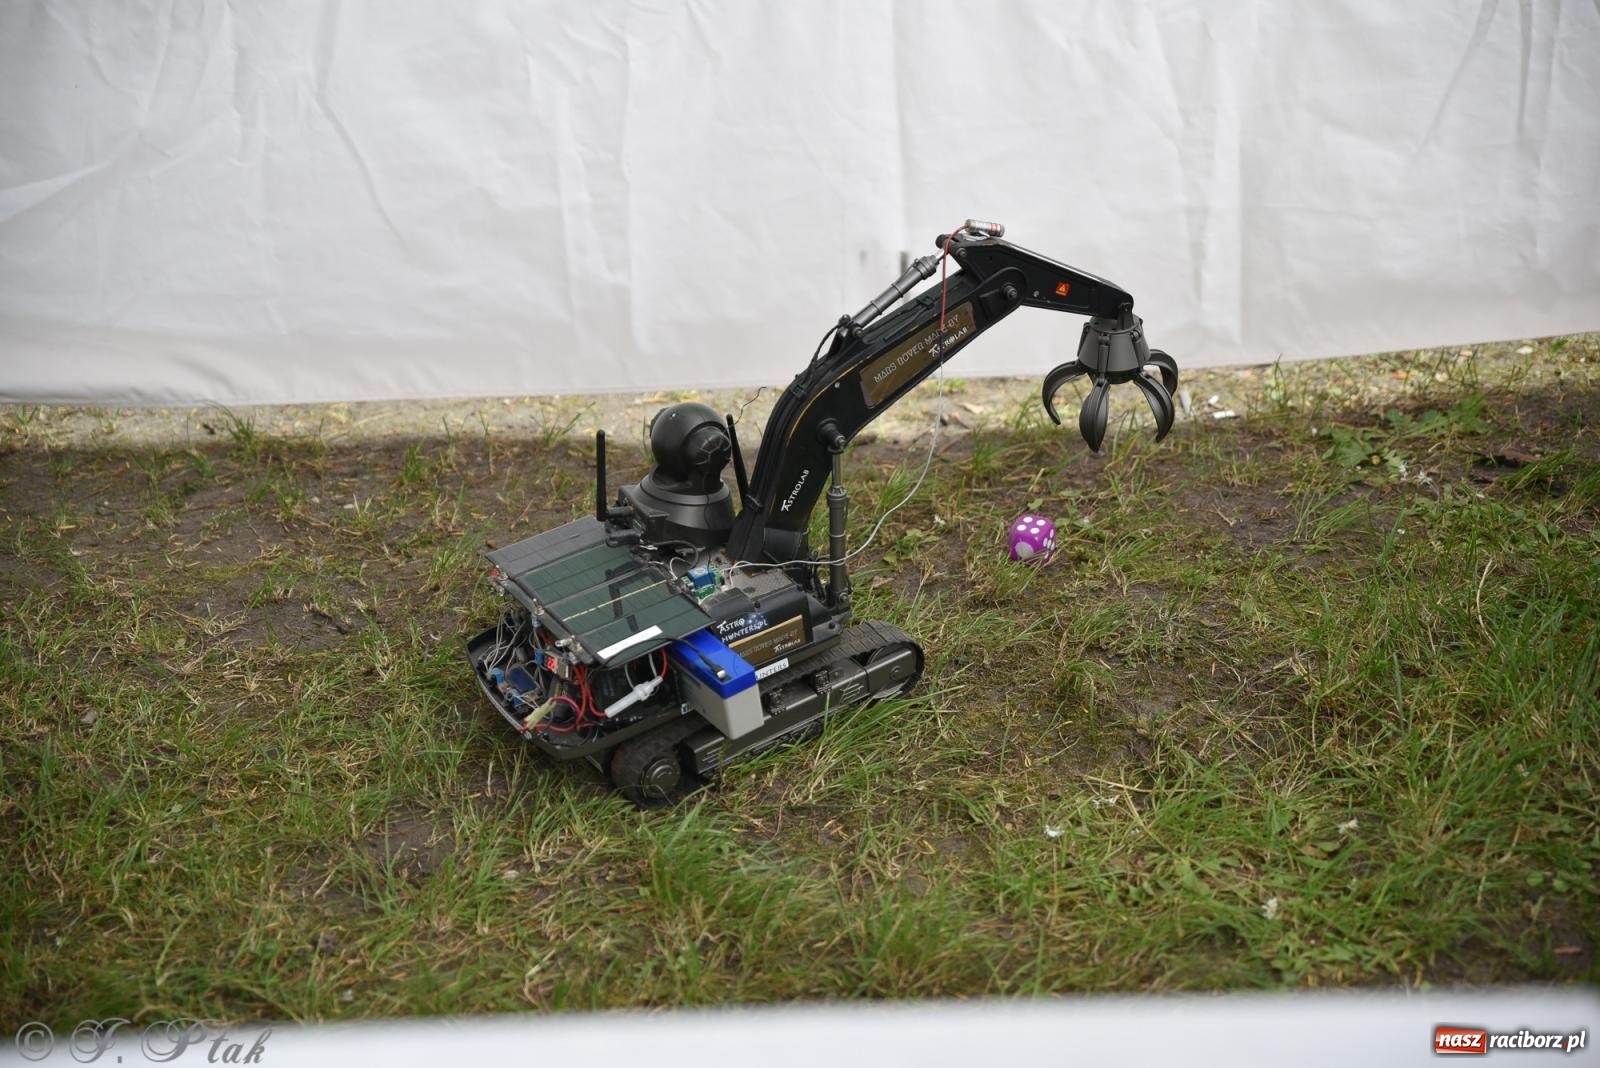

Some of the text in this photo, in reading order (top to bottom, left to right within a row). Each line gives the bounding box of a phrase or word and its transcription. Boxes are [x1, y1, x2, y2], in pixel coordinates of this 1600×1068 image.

[873, 362, 897, 384] MARS
[896, 342, 925, 367] ROVER
[780, 469, 809, 512] ASTROLAB
[716, 618, 745, 633] ASTRO
